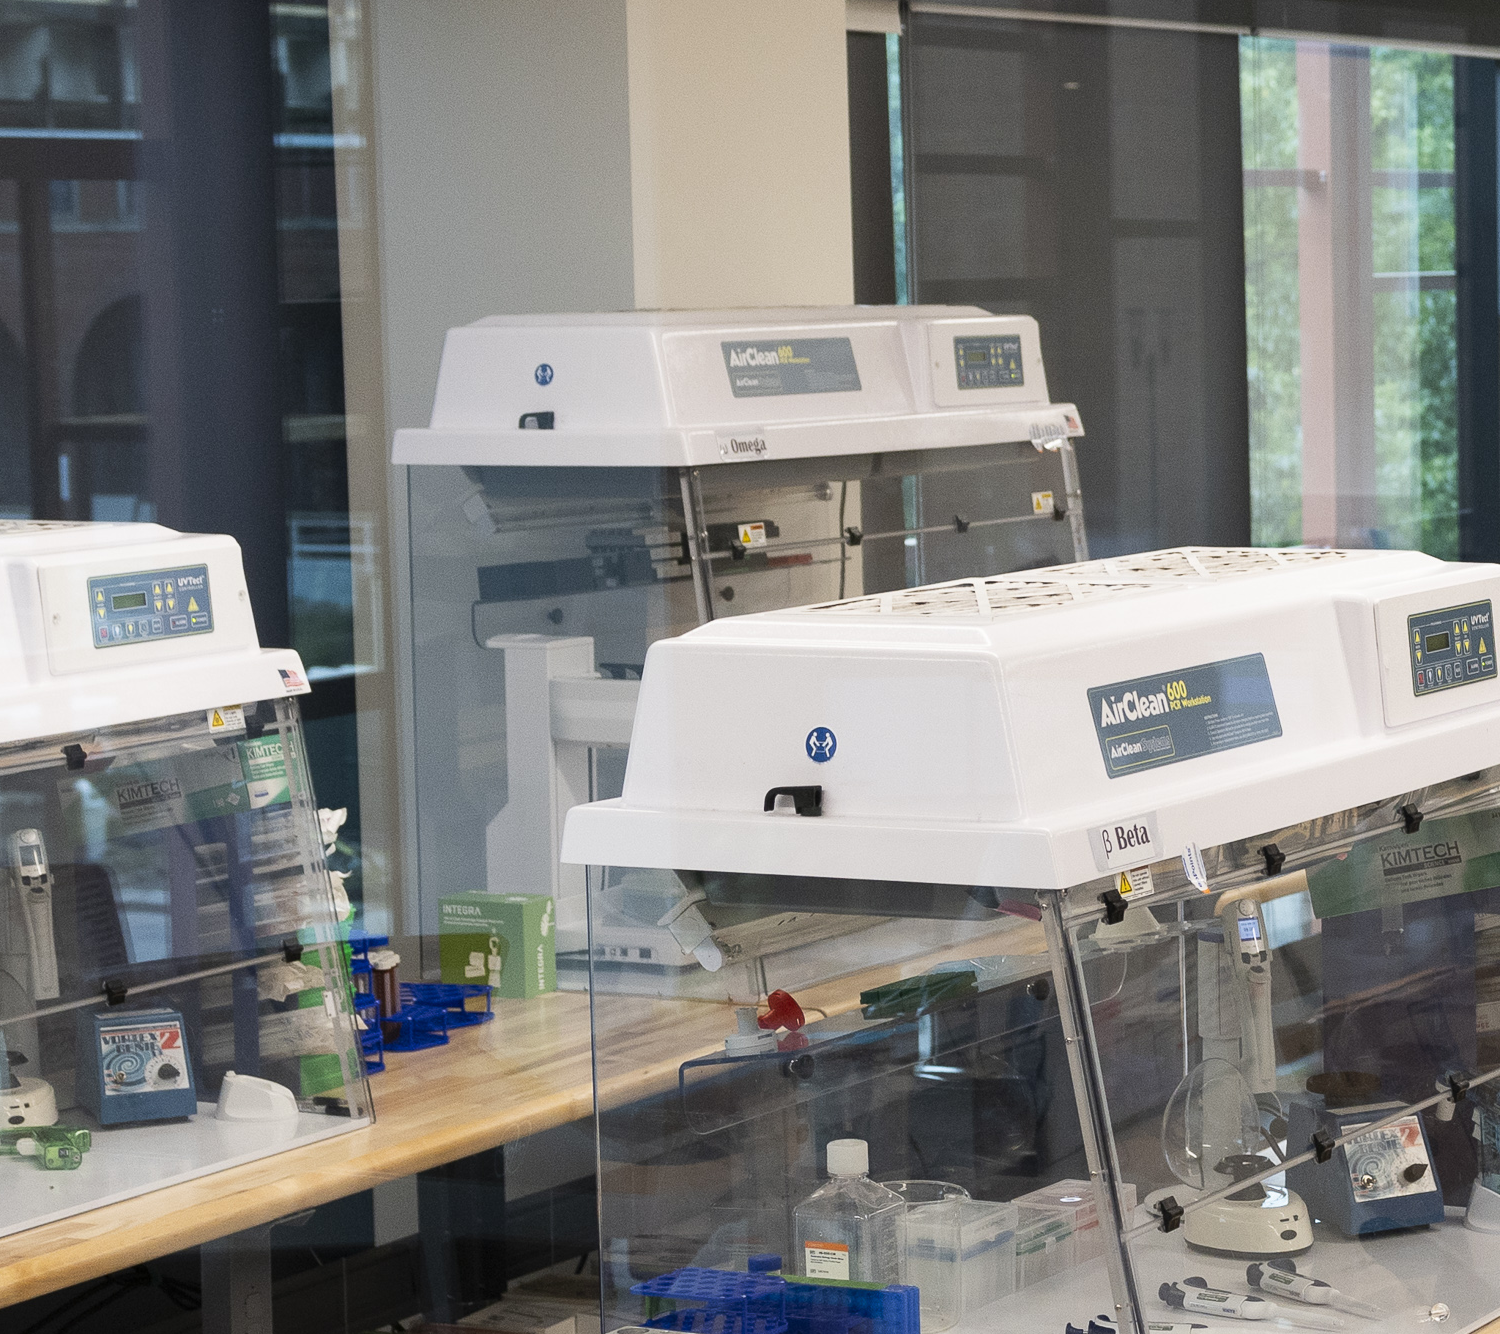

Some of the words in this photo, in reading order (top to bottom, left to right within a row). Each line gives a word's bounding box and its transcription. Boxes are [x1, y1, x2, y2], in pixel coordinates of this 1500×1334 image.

[730, 348, 779, 367] AirClean
[731, 438, 767, 456] Omega
[177, 575, 204, 587] UVTect
[1471, 613, 1489, 625] UVTect
[1100, 691, 1170, 728] AirClean
[1167, 680, 1187, 700] 600
[1169, 700, 1182, 711] PCR
[1182, 695, 1211, 708] Workstation
[117, 778, 181, 803] KIMTECH
[1115, 824, 1150, 851] Beta
[1380, 841, 1460, 868] KIMTECH
[1423, 859, 1446, 868] SCIENCE
[442, 904, 482, 916] INTEGRA
[537, 944, 546, 991] INTEGRA
[102, 1032, 158, 1045] VORTEX
[160, 1030, 181, 1050] 2
[115, 1040, 161, 1057] GENIE
[1399, 1126, 1423, 1148] 2
